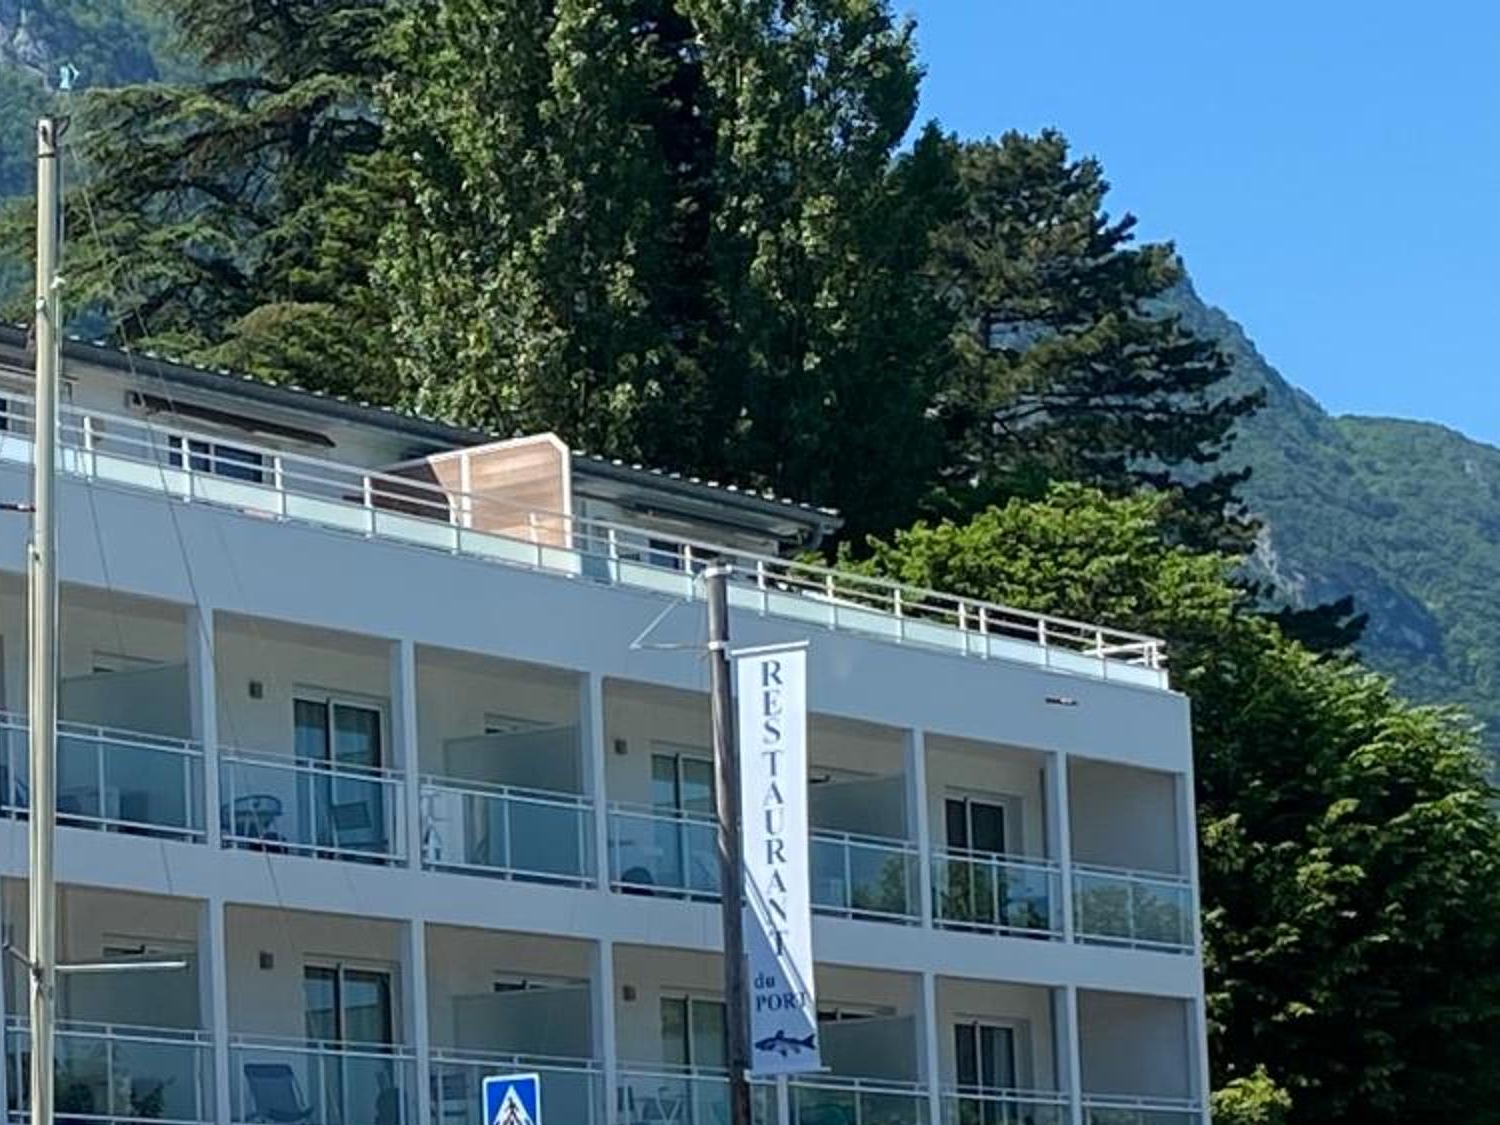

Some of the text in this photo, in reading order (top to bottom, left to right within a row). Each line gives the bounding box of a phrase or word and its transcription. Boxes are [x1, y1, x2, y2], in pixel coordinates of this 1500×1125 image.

[760, 659, 790, 957] RESTAURANT
[754, 972, 776, 989] du
[755, 992, 807, 1011] PORT
